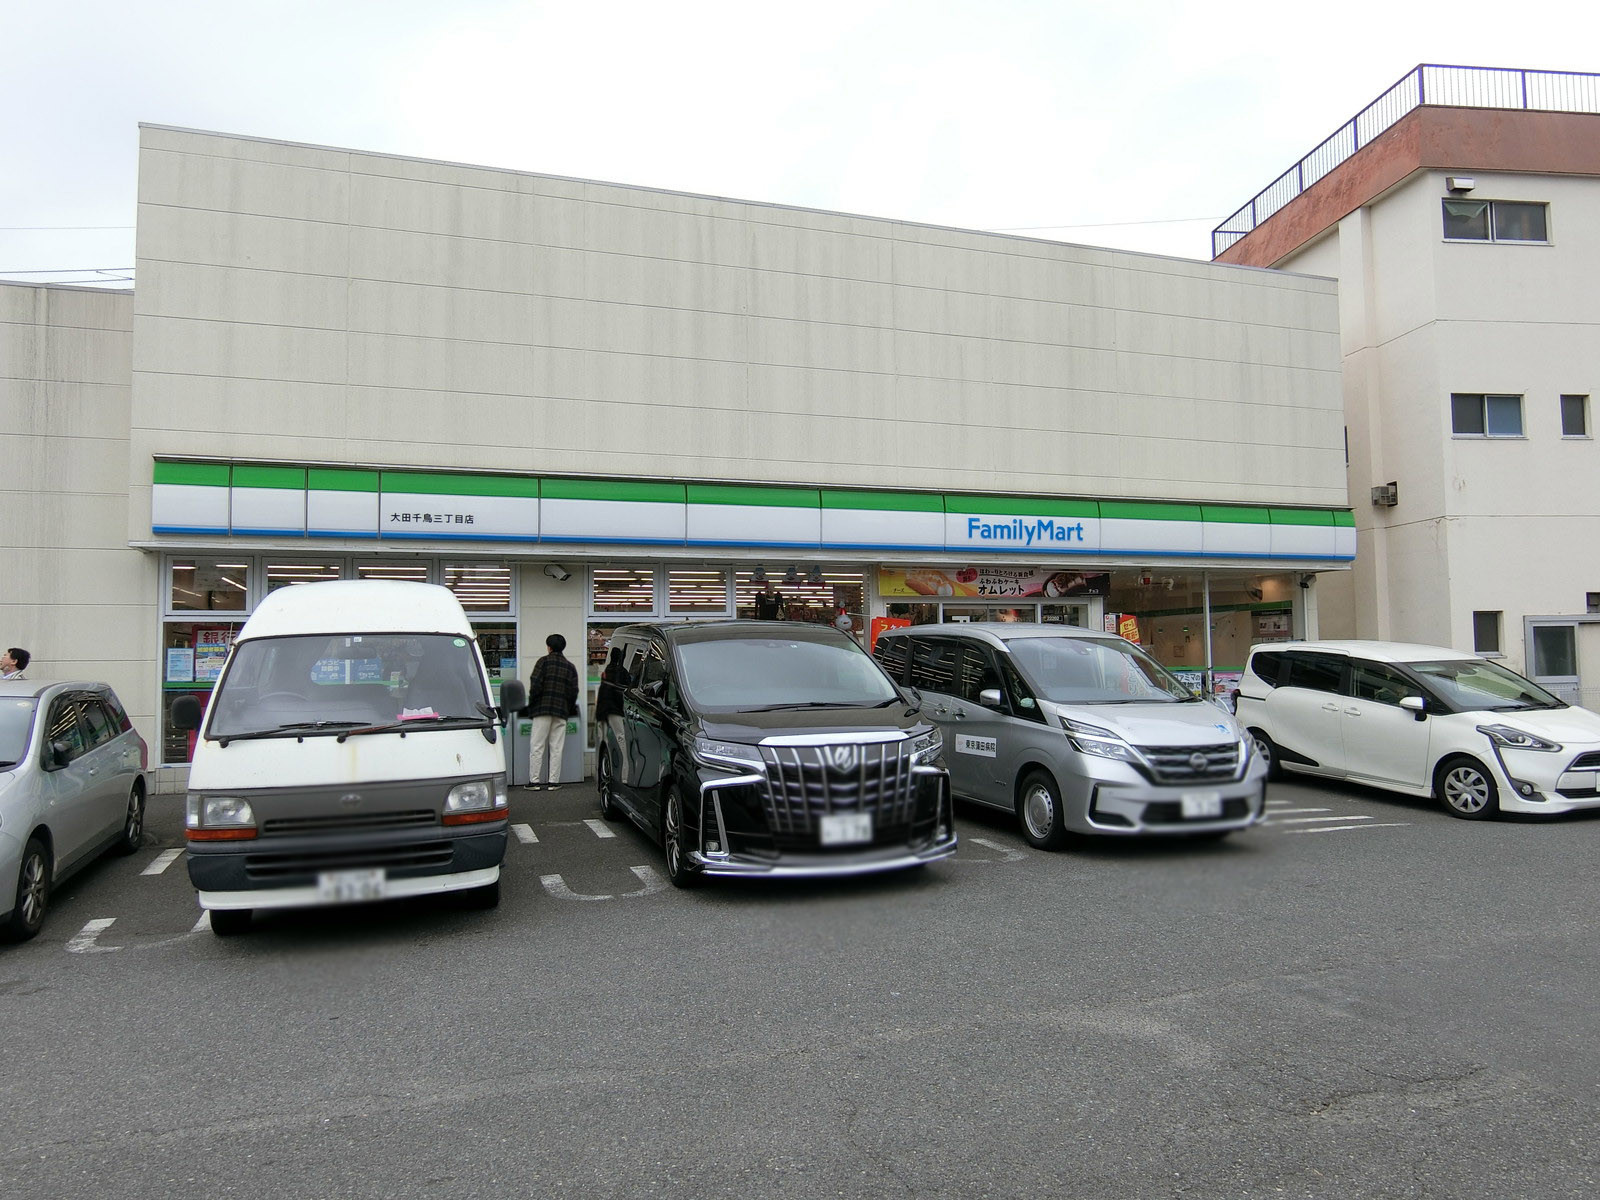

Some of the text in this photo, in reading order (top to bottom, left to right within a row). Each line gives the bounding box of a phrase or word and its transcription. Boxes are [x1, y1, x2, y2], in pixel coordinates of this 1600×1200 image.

[390, 512, 474, 524] 大田千鳥三丁目店
[967, 517, 1084, 546] FamilyMart
[978, 584, 1024, 596] オムレット
